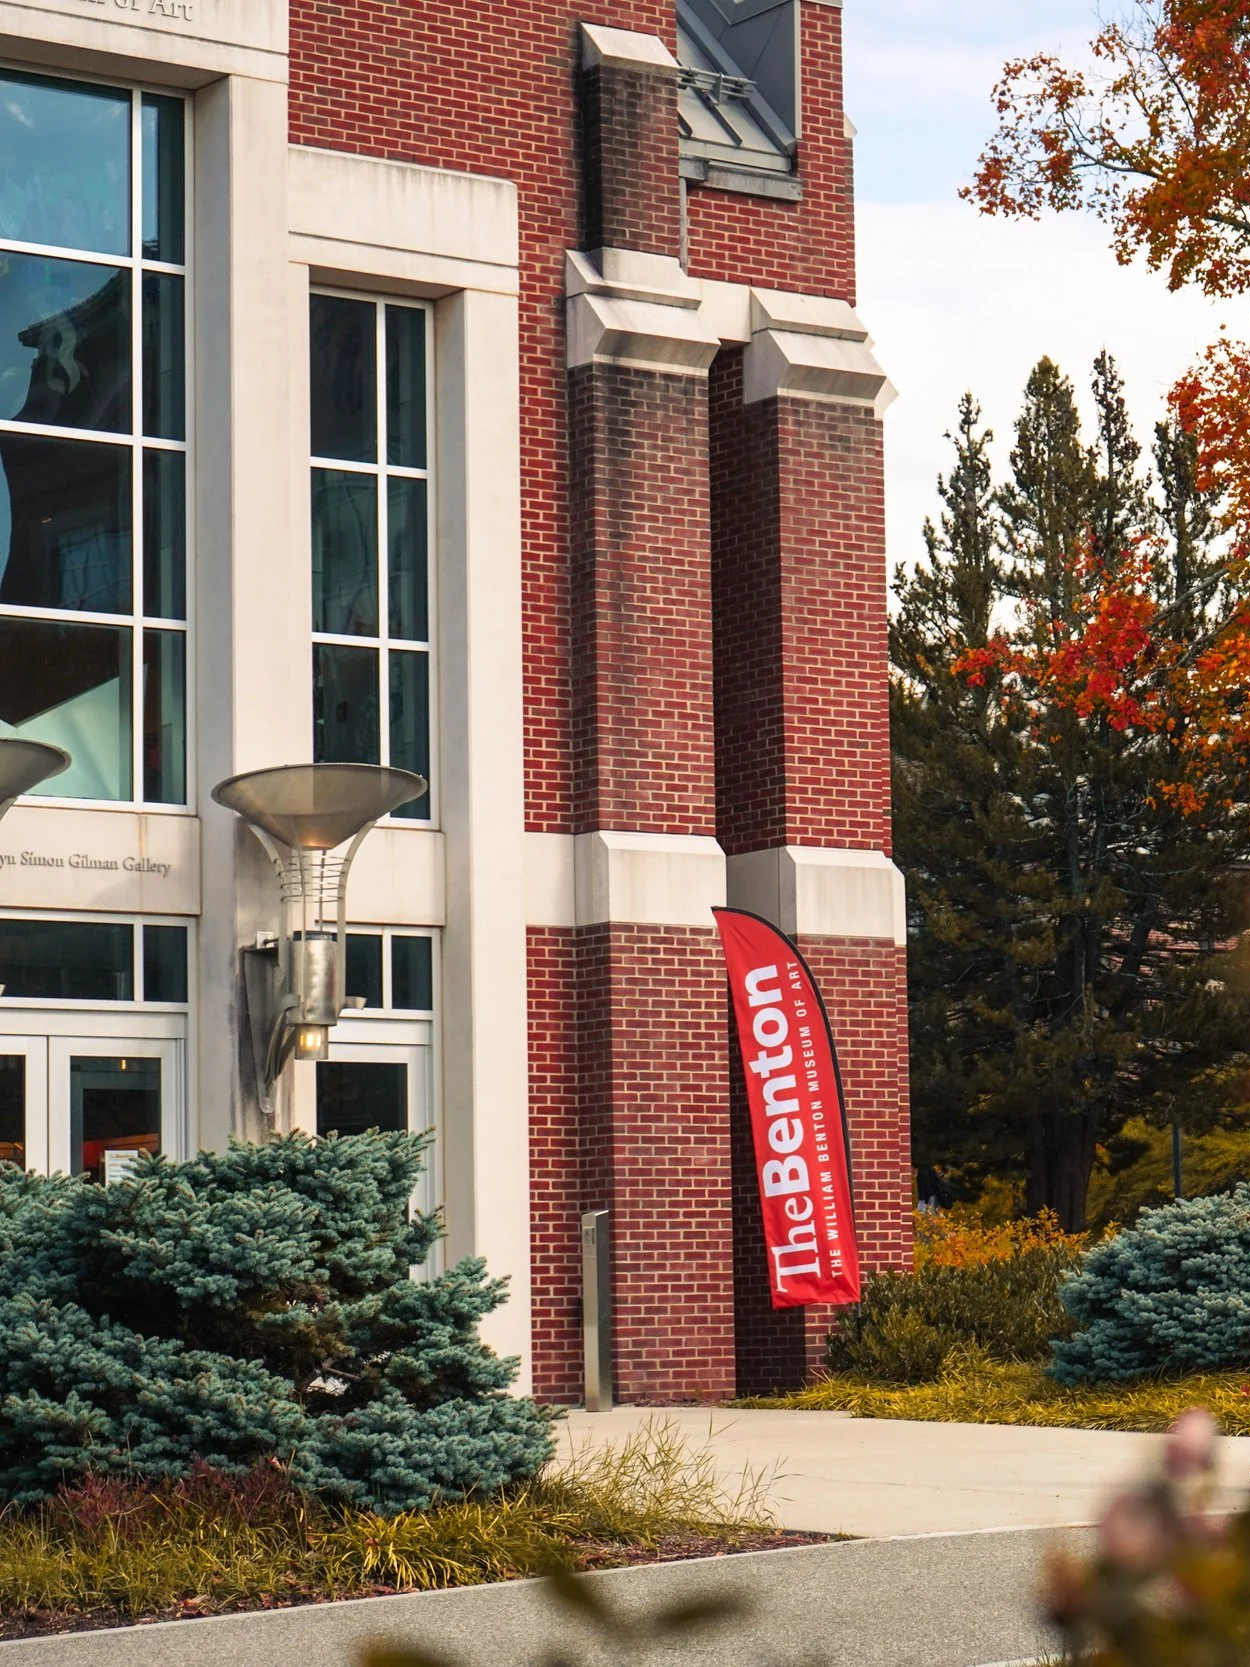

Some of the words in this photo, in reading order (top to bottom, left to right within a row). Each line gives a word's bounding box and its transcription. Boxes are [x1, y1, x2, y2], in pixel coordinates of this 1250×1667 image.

[20, 851, 65, 868] Simon
[68, 854, 119, 870] Gilman
[122, 857, 172, 877] Gallery
[786, 961, 803, 990] ART
[793, 999, 807, 1018] OF
[798, 1026, 820, 1093] MUSEUM
[810, 1100, 830, 1163] BENTON
[820, 1171, 839, 1241] WILLIAM
[829, 1249, 843, 1278] THE
